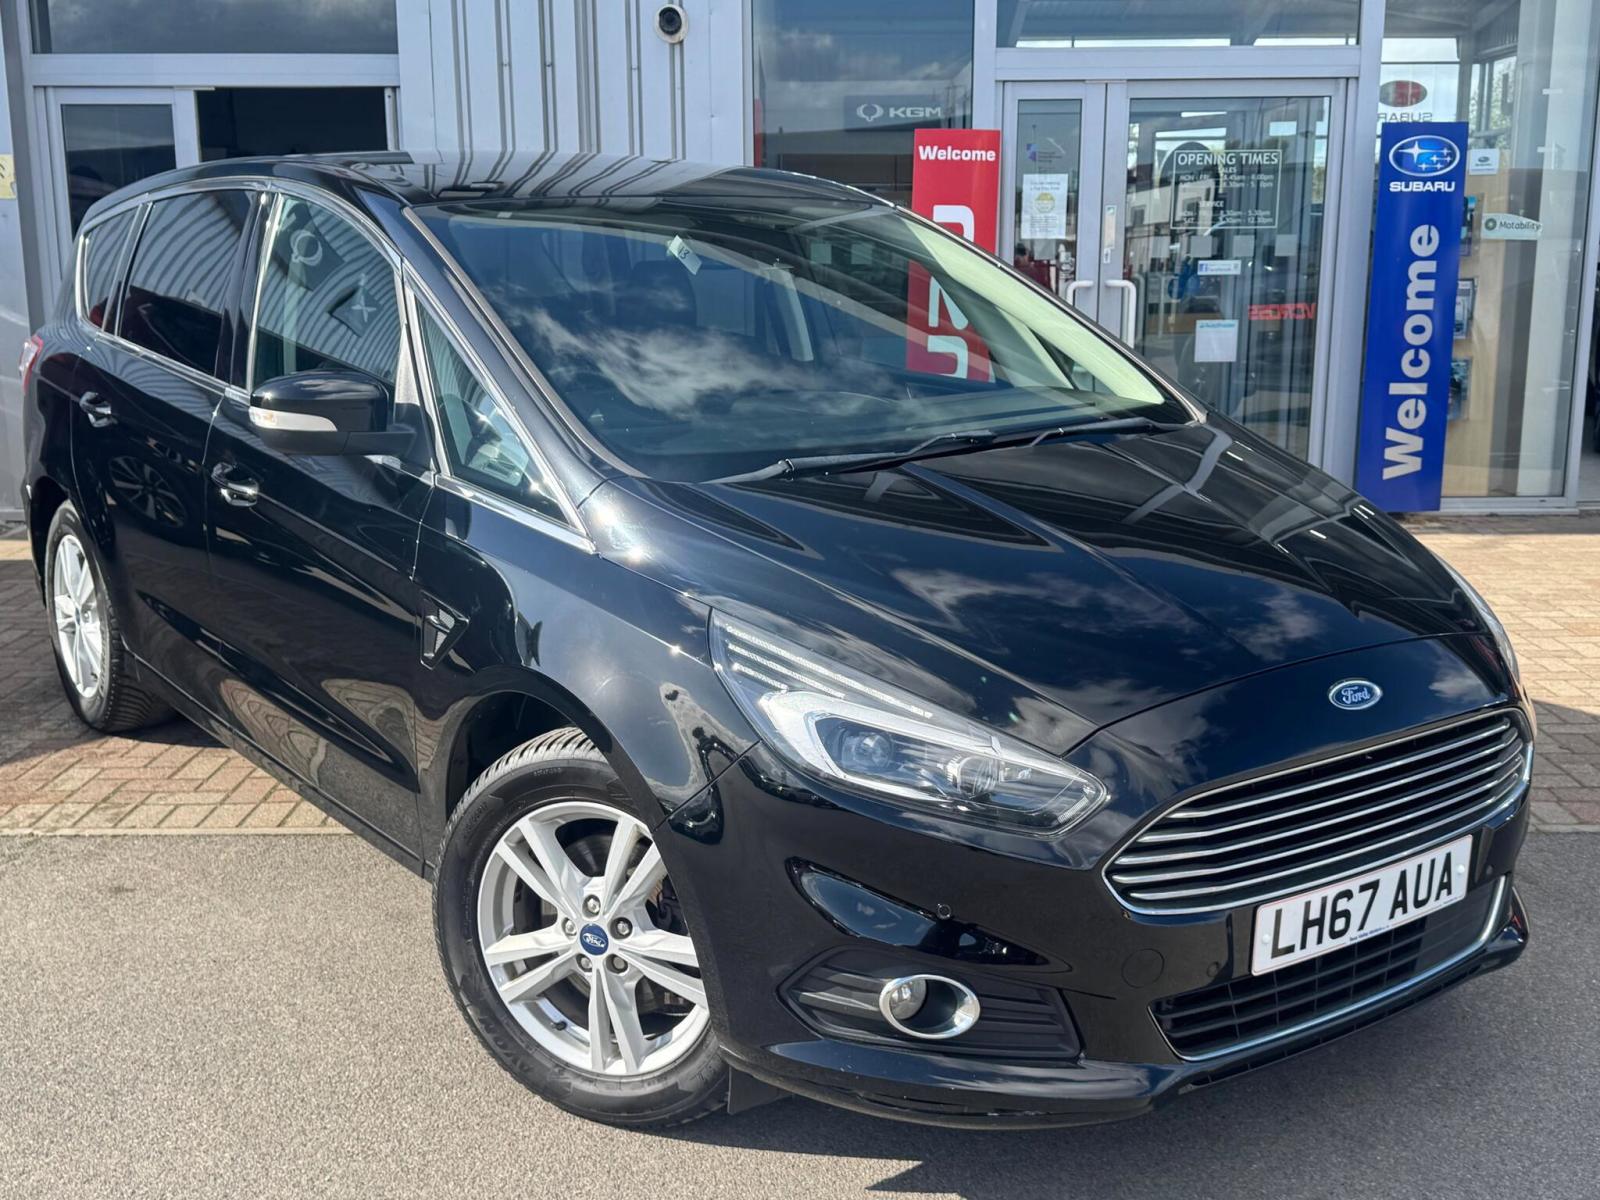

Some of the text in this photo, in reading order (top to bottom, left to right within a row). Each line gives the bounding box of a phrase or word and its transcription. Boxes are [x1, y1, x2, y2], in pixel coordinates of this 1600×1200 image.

[889, 107, 943, 118] KGM
[919, 145, 996, 161] Welcome
[1178, 152, 1278, 165] OPENING TIMES
[1389, 181, 1456, 192] SUBARU
[1499, 221, 1541, 231] Motability
[1382, 224, 1440, 480] Welcome
[1341, 685, 1371, 704] Ford
[1271, 851, 1452, 959] LH67 AUA
